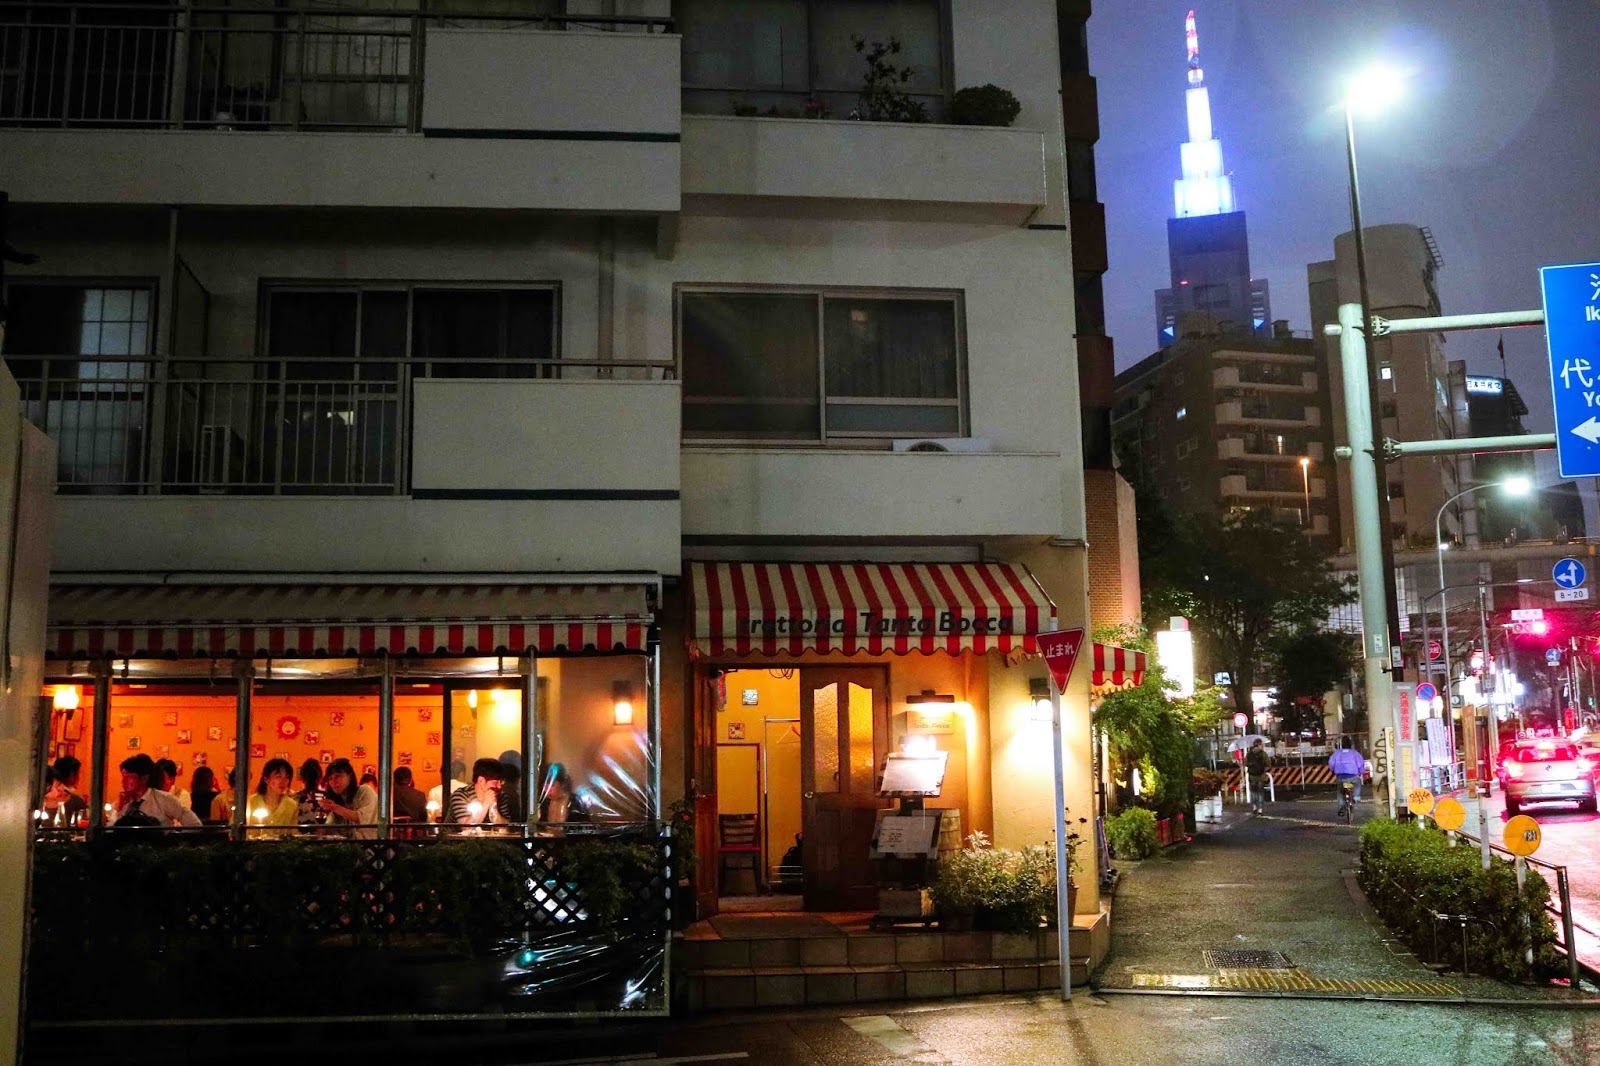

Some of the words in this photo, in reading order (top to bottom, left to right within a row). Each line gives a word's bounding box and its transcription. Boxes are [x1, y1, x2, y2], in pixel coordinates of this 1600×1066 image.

[1560, 358, 1600, 389] 代
[939, 611, 1013, 632] Bocca
[1046, 642, 1074, 658] 止まれ
